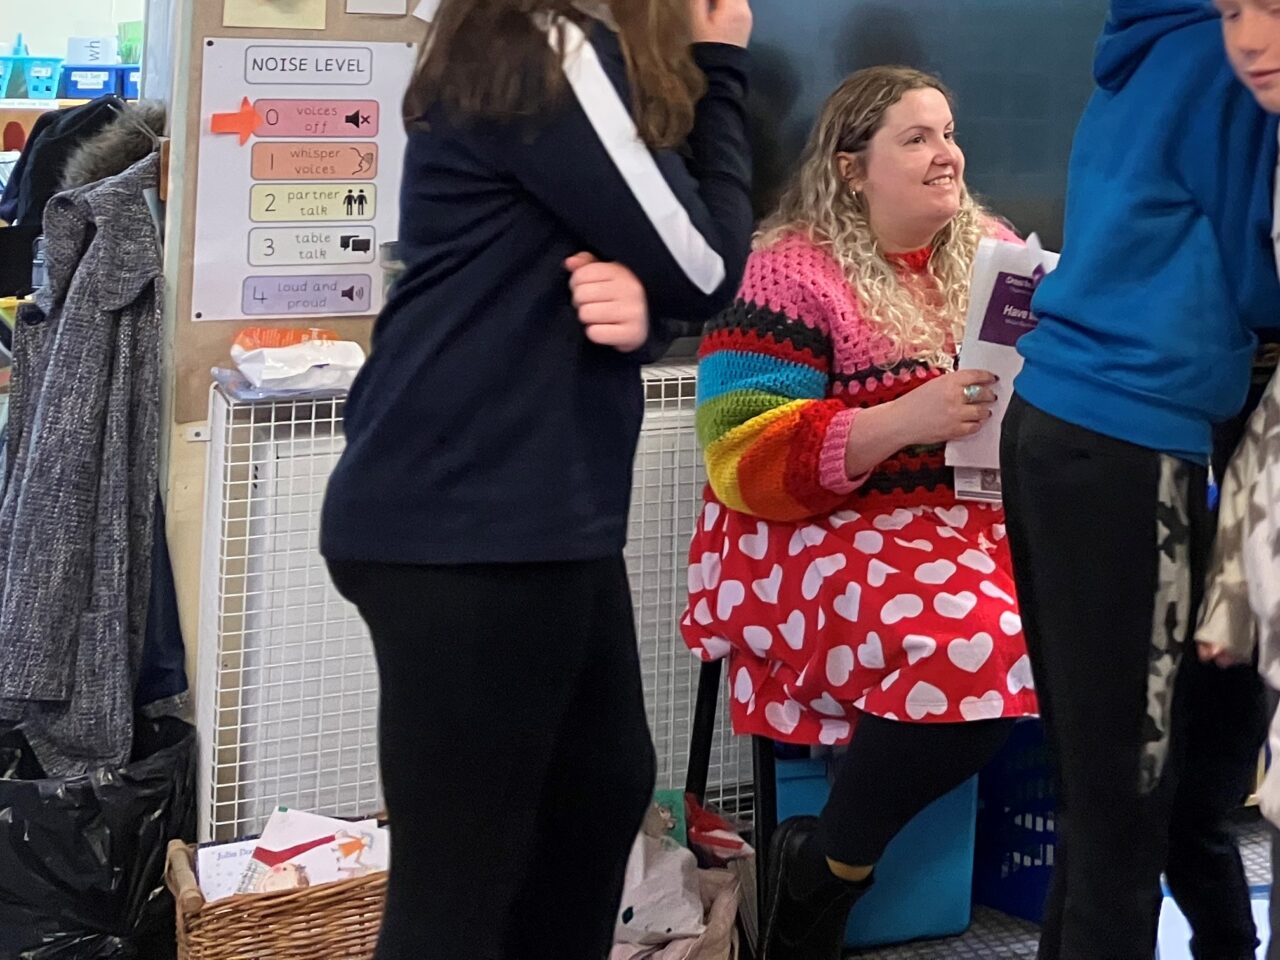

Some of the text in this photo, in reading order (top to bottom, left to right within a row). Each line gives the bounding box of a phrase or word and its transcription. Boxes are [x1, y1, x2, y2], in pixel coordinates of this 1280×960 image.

[252, 57, 365, 72] NOISE LEVEL
[265, 108, 279, 126] 0
[296, 106, 338, 117] voices
[304, 121, 327, 134] off
[290, 148, 341, 162] whisper
[294, 164, 336, 175] voices
[264, 193, 276, 212] 2
[287, 189, 340, 204] partner
[300, 204, 328, 217] talk
[295, 232, 331, 244] table
[263, 238, 275, 256] 3
[298, 248, 327, 260] talk
[277, 281, 338, 292] loud and
[253, 287, 268, 304] 4
[287, 297, 327, 311] proud
